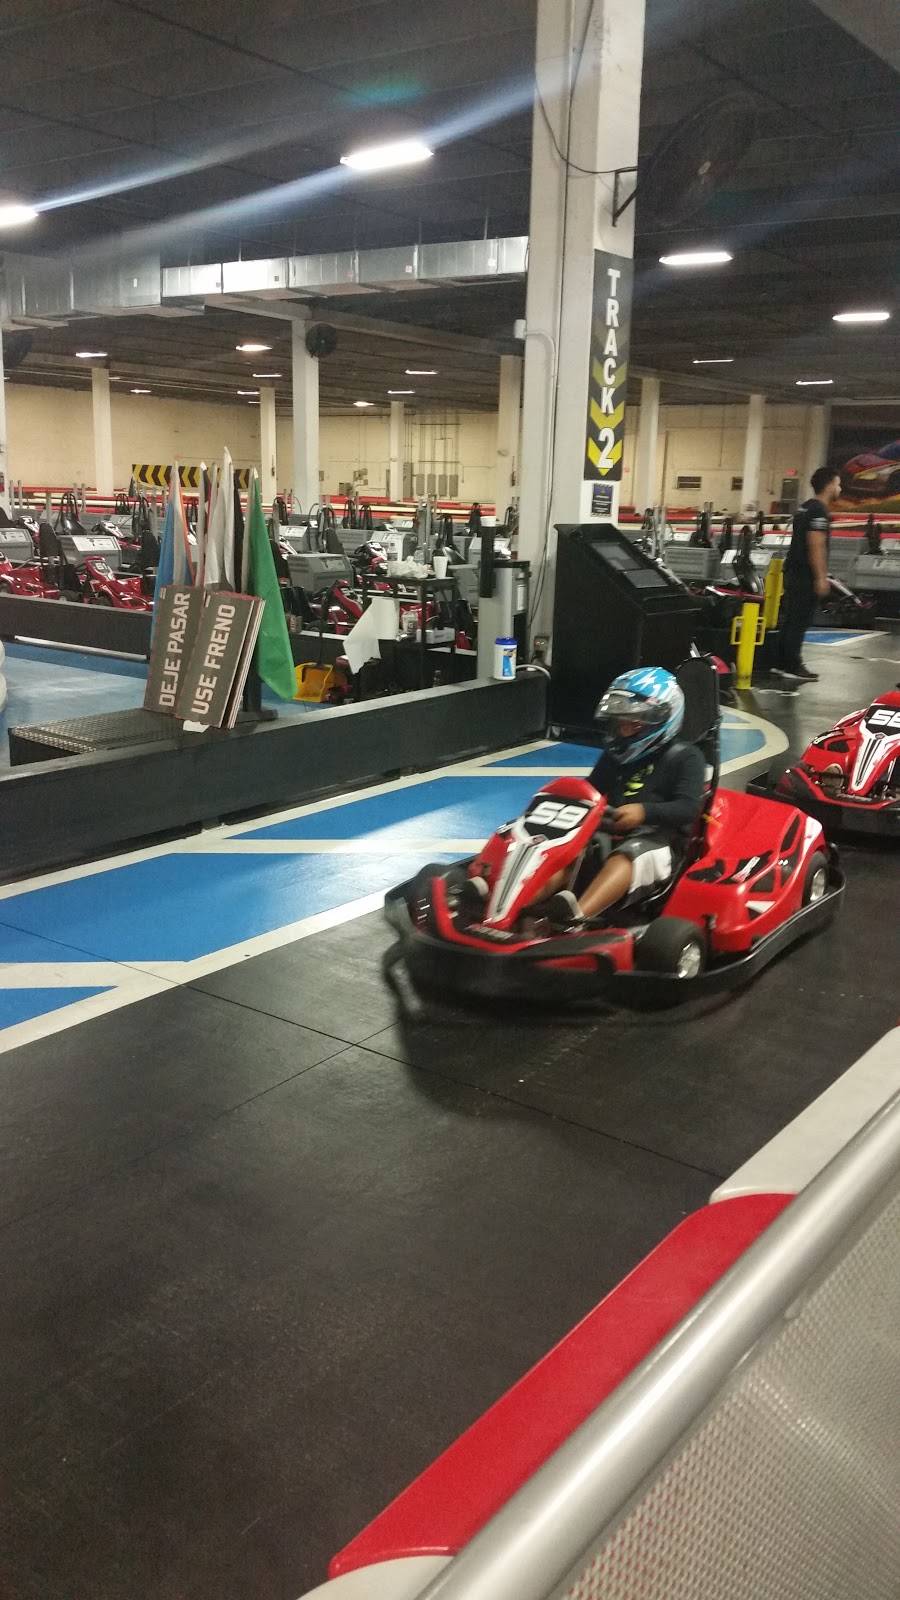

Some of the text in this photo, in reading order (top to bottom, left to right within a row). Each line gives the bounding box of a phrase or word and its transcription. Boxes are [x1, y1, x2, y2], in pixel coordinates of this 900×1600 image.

[601, 268, 620, 414] TRACK
[596, 427, 615, 469] 2
[159, 592, 191, 707] DEJE PASAR
[191, 604, 236, 715] USE FRENO
[525, 801, 589, 830] 59
